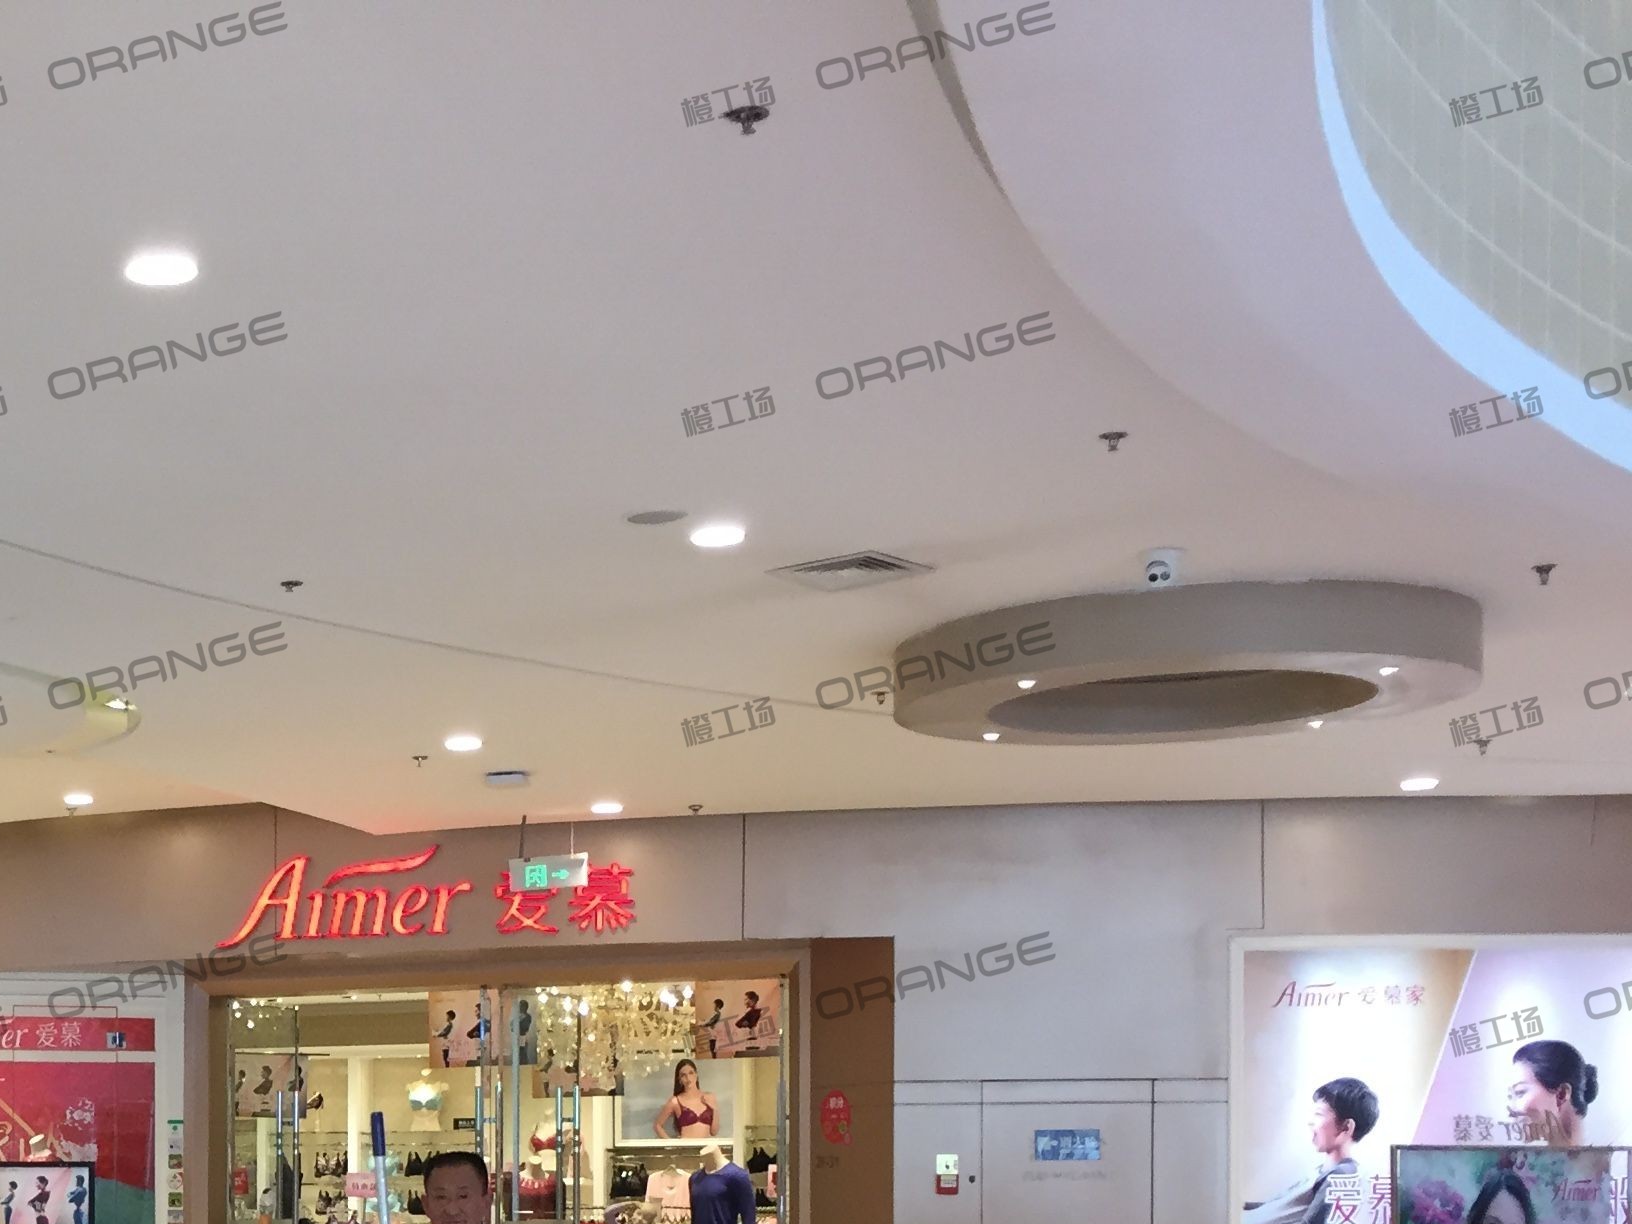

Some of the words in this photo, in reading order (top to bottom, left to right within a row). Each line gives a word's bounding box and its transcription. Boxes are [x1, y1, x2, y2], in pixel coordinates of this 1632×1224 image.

[215, 845, 472, 949] Aimer
[1271, 981, 1350, 1008] Aimer
[1357, 981, 1427, 1007] 爱慕家
[36, 1021, 82, 1049] 爱慕
